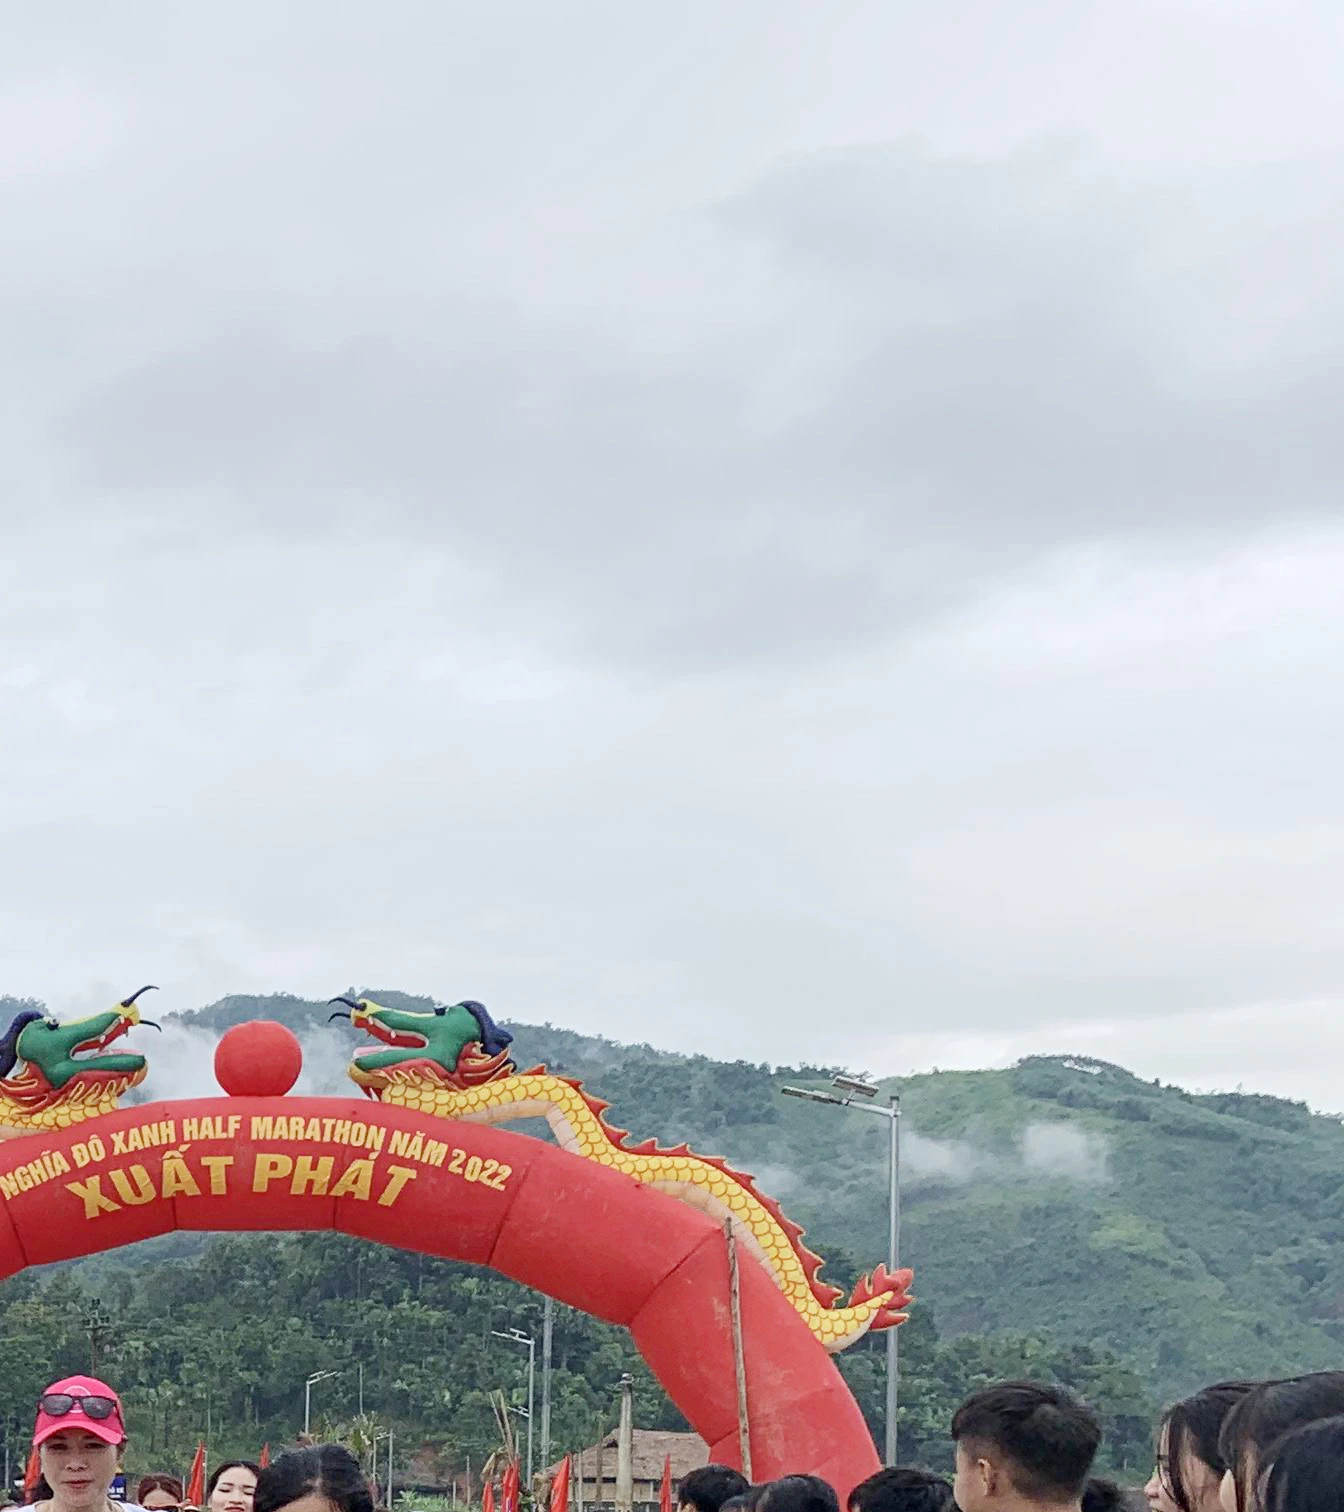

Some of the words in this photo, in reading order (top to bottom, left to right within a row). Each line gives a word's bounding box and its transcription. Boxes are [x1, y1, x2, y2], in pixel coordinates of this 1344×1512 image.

[64, 1143, 235, 1220] XUẤT
[252, 1151, 418, 1208] PHÁT
[70, 1134, 108, 1169] ĐÔ
[110, 1120, 178, 1156] XANH
[182, 1115, 243, 1142] HALF
[250, 1116, 387, 1151] MARATHON
[387, 1130, 450, 1168] NĂM
[447, 1148, 513, 1192] 2022
